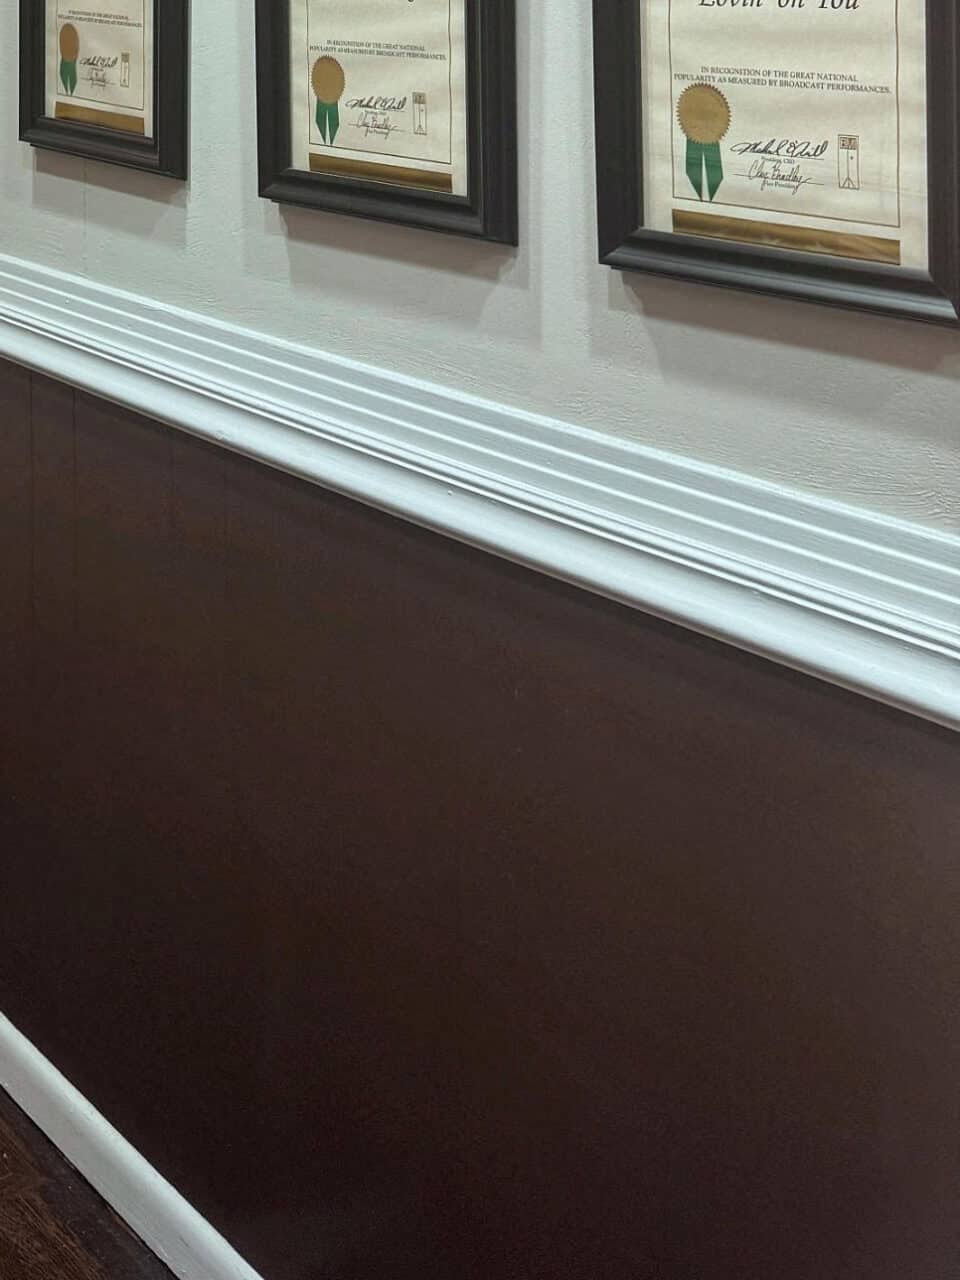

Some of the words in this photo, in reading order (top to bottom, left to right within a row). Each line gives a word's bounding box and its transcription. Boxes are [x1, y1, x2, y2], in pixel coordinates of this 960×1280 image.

[674, 73, 716, 82] POPULARITY
[728, 77, 766, 85] MEASURED
[779, 80, 824, 89] BROADCAST
[711, 67, 761, 76] RECOGNITION
[774, 70, 789, 78] THE
[790, 71, 815, 79] GREAT
[817, 73, 858, 82] NATIONAL
